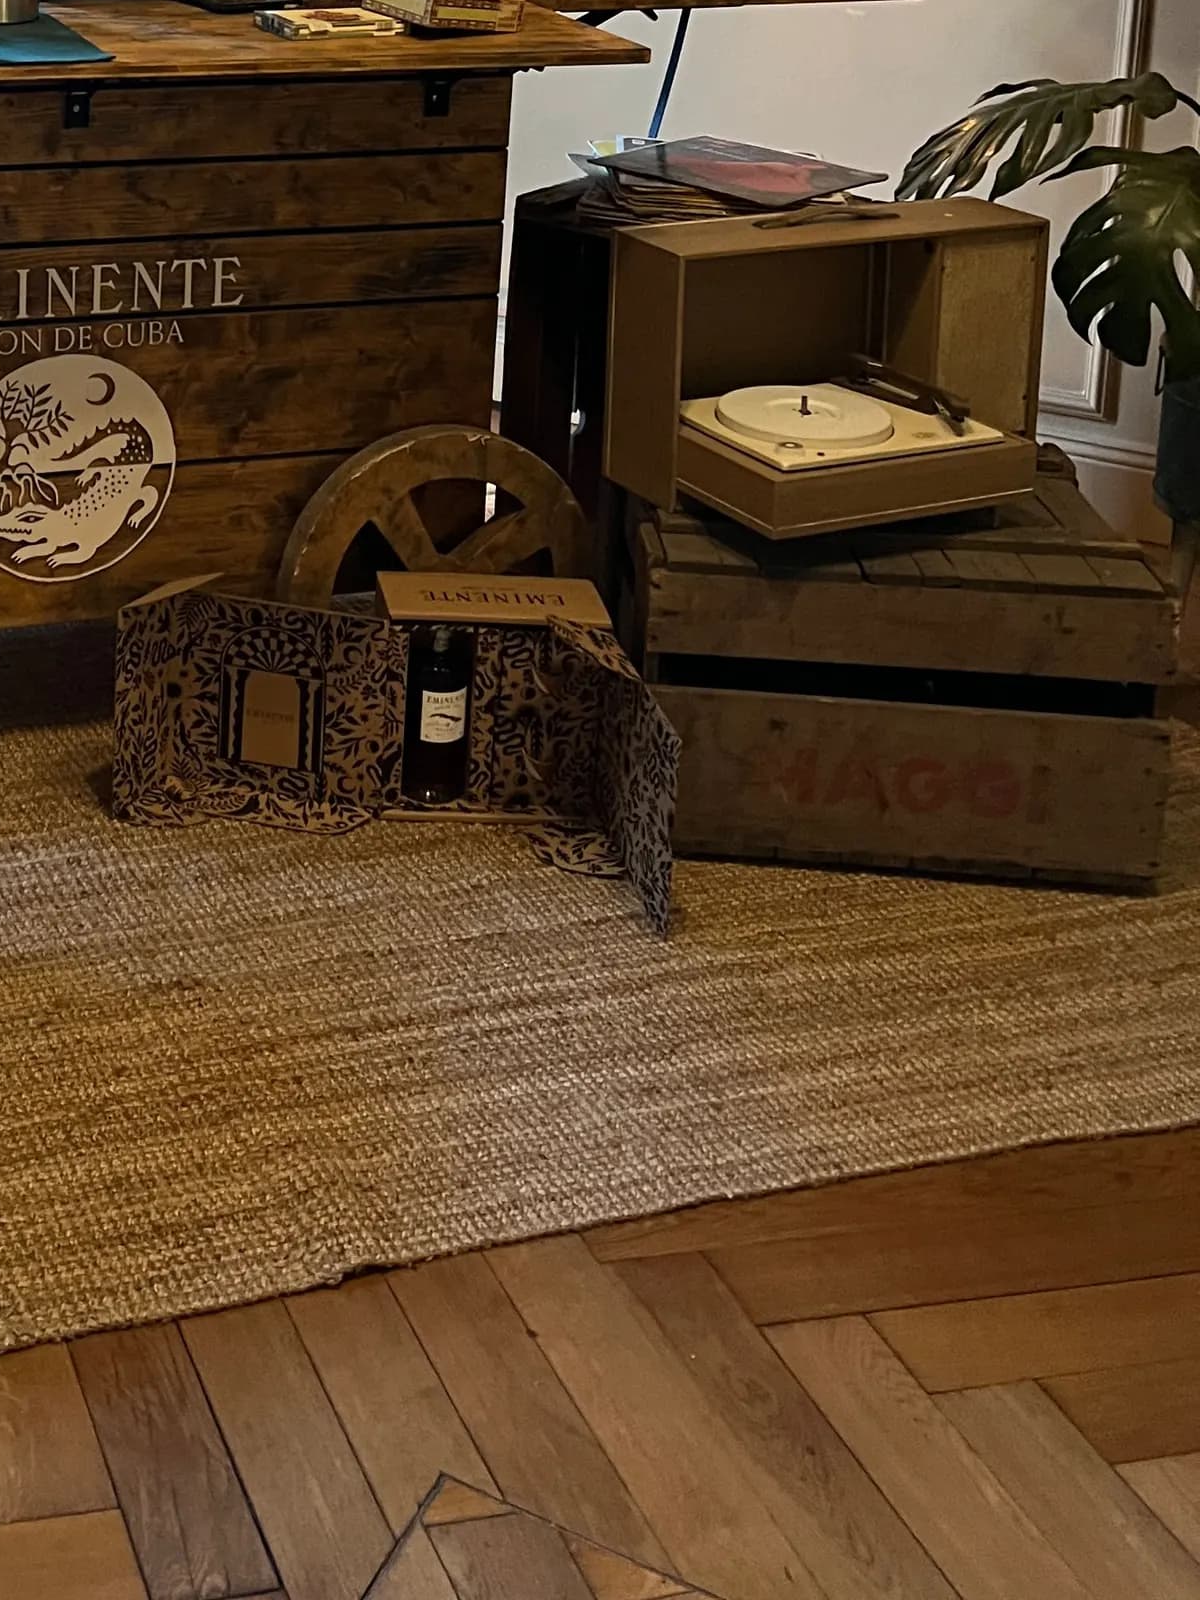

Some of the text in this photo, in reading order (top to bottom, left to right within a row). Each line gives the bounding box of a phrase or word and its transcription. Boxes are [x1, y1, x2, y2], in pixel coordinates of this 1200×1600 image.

[54, 325, 94, 352] DE
[102, 319, 185, 350] CUBA
[418, 589, 565, 607] EMINENTE
